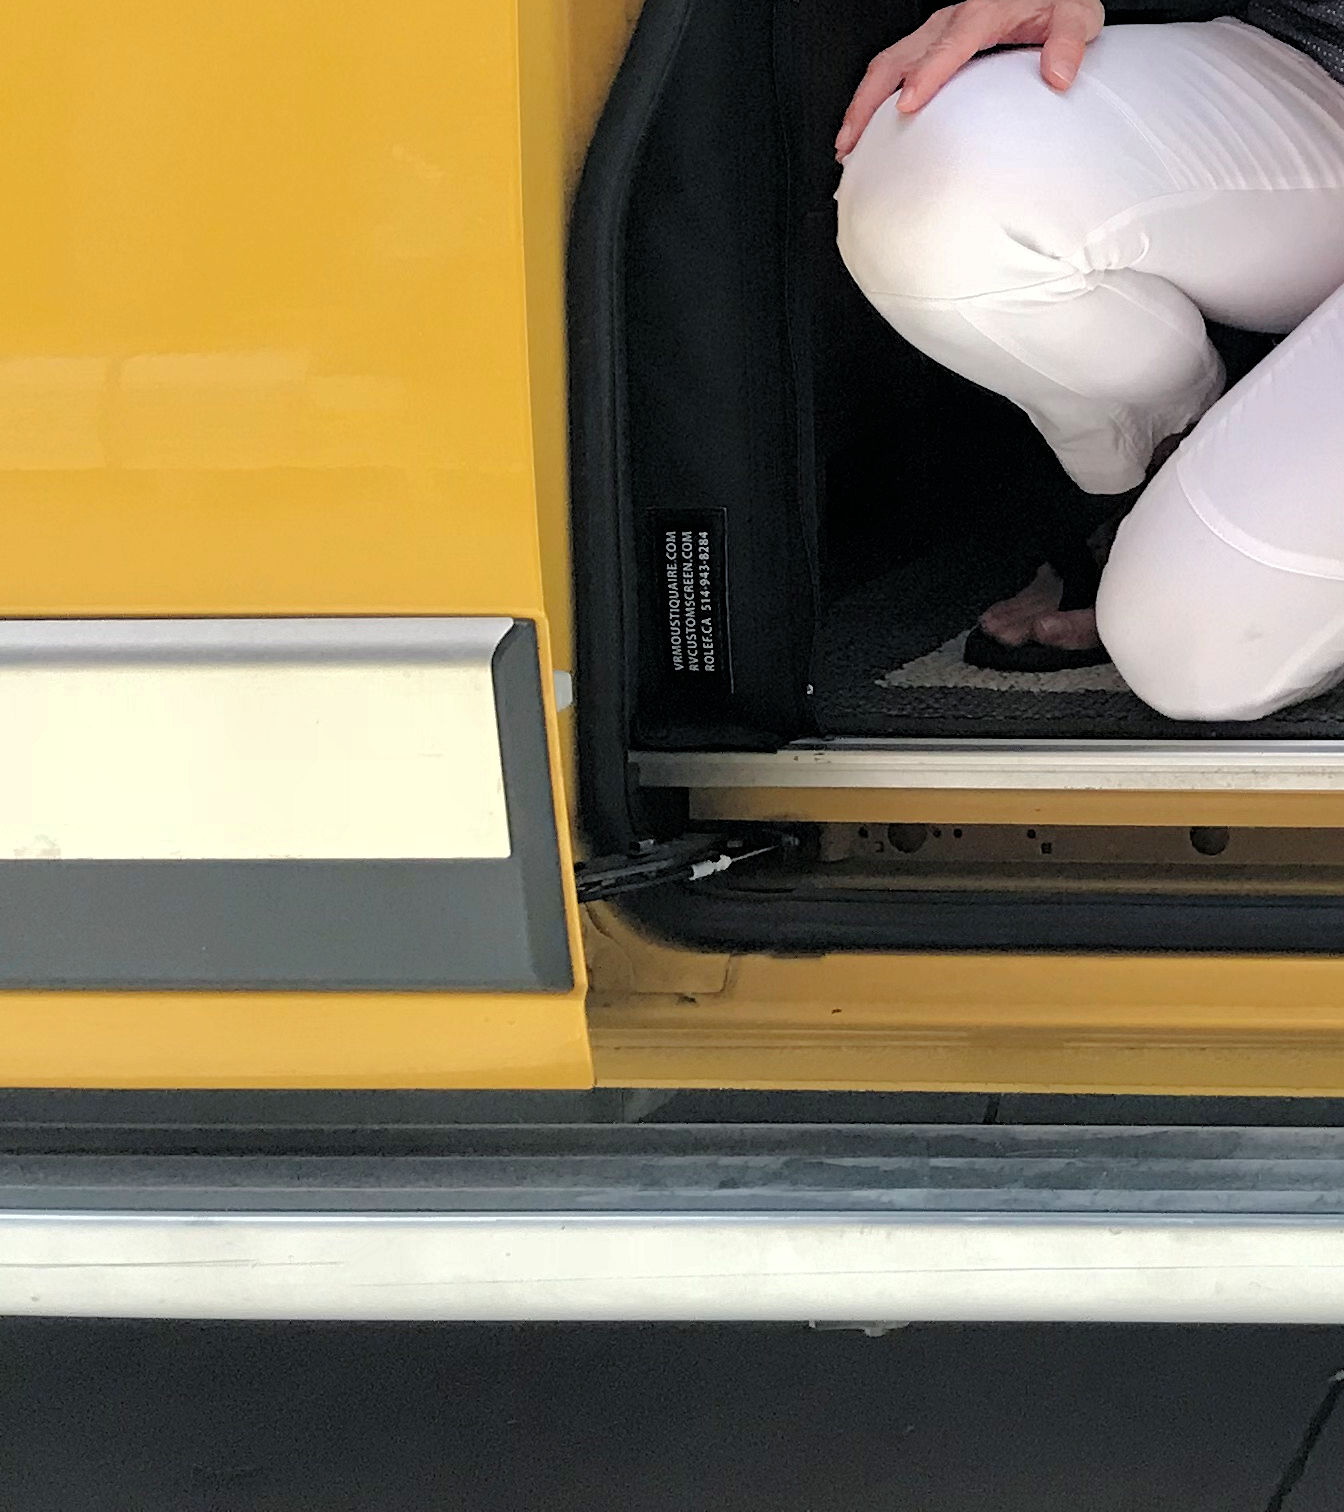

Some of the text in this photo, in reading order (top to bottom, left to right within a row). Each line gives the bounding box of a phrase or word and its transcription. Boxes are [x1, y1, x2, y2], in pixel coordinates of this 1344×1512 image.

[665, 530, 685, 672] VRMOUSTIQUAIRE.COM
[682, 530, 700, 672] RVCUSTOMSCREEN.COM
[698, 531, 715, 672] ROLEF.CA 514-943-8284
